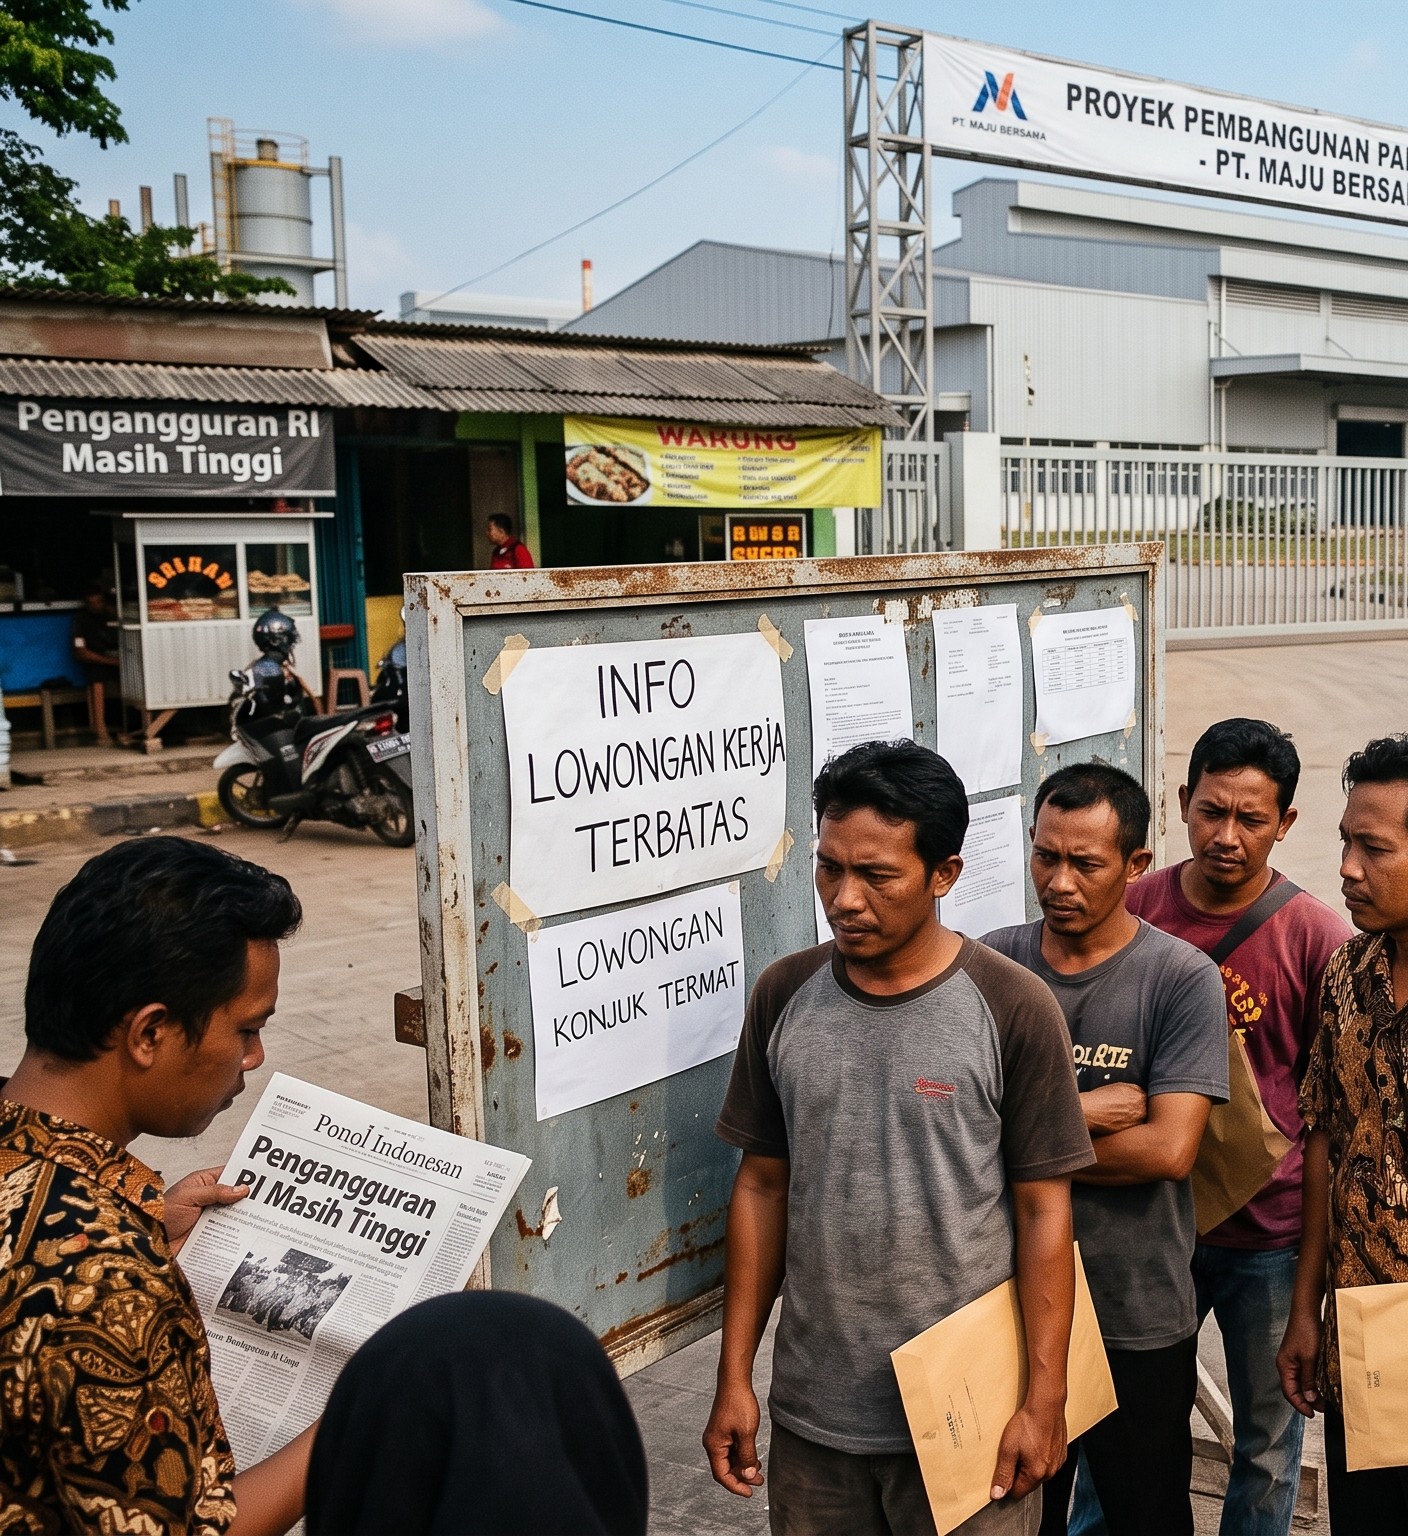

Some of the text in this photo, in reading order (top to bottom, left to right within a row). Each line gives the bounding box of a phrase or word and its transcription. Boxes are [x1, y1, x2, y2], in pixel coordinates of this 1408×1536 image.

[952, 116, 1046, 141] PT. MAJU BERSAMA
[1067, 82, 1175, 130] PROYEK
[1185, 105, 1369, 164] PEMBANGUNAN
[1216, 149, 1249, 180] PT.
[1259, 156, 1324, 192] MAJU
[18, 401, 320, 443] Pengangguran RI
[62, 443, 283, 482] Masih Tinggi
[598, 659, 695, 718] INFO
[528, 730, 715, 804] LOWONGAN
[575, 796, 748, 872] TERBATAS
[557, 906, 723, 988] LOWONGAN
[553, 960, 739, 1047] KONJUK TERMAT
[248, 1134, 437, 1220] Pengangguran
[371, 1134, 463, 1180] Indonesan
[264, 1179, 344, 1229] Masih
[353, 1206, 431, 1259] Tinggi
